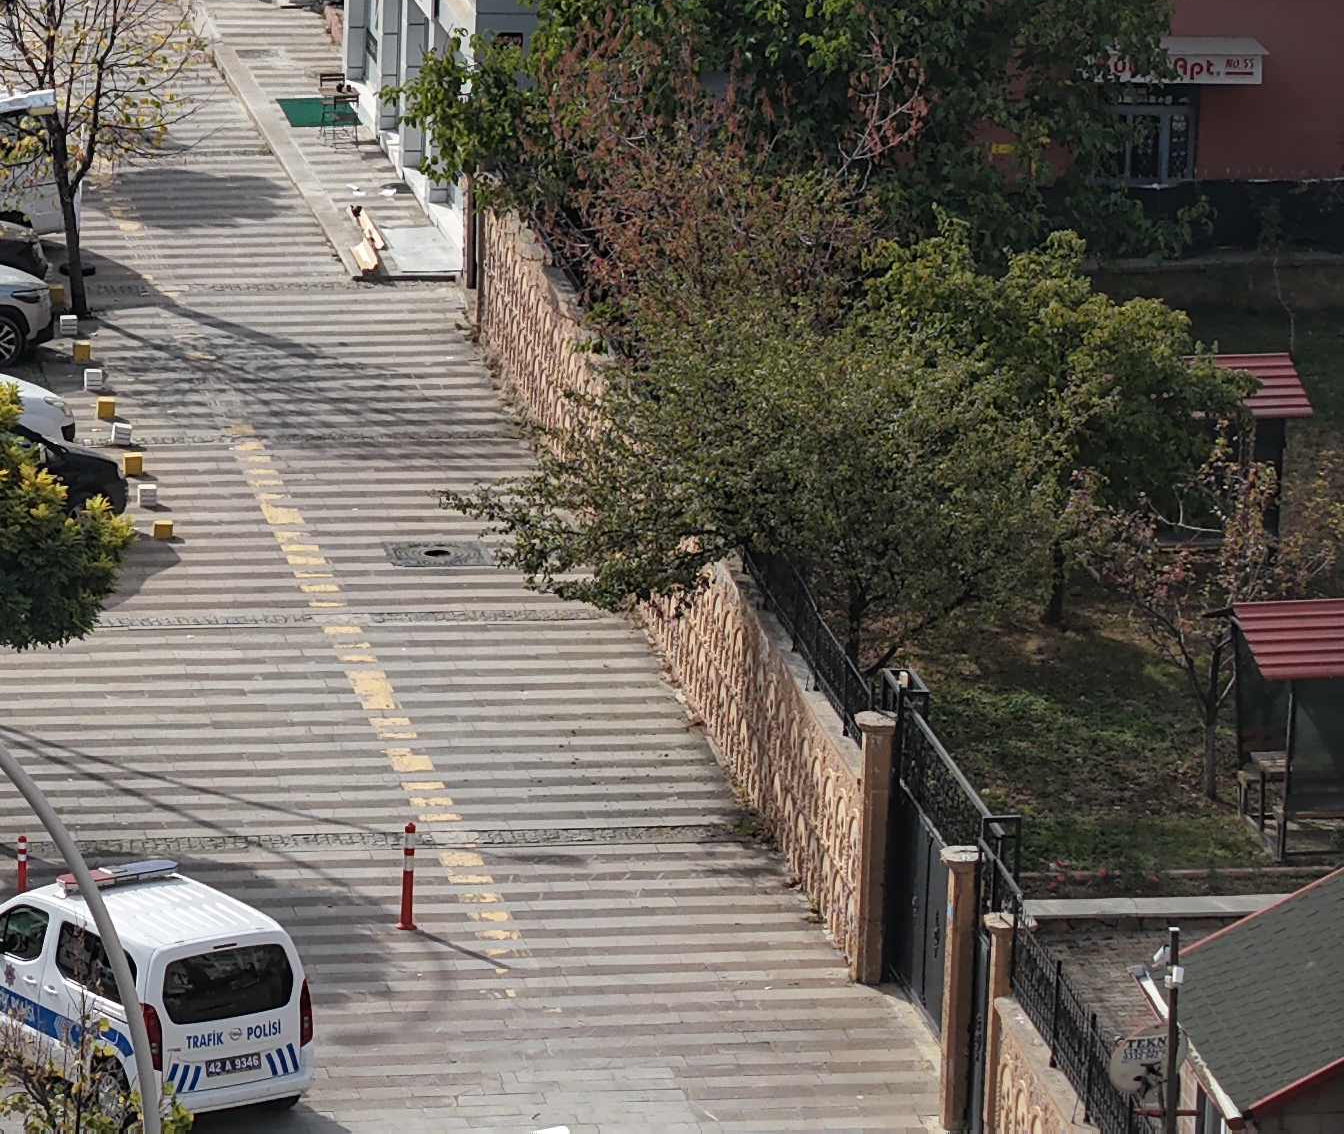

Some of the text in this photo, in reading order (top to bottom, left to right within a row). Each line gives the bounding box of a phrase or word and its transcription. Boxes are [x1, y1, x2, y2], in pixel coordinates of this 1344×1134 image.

[186, 1019, 281, 1049] TRAFİK POLİSİ
[1127, 1036, 1167, 1048] TEKN
[208, 1055, 259, 1073] 42 A 9346
